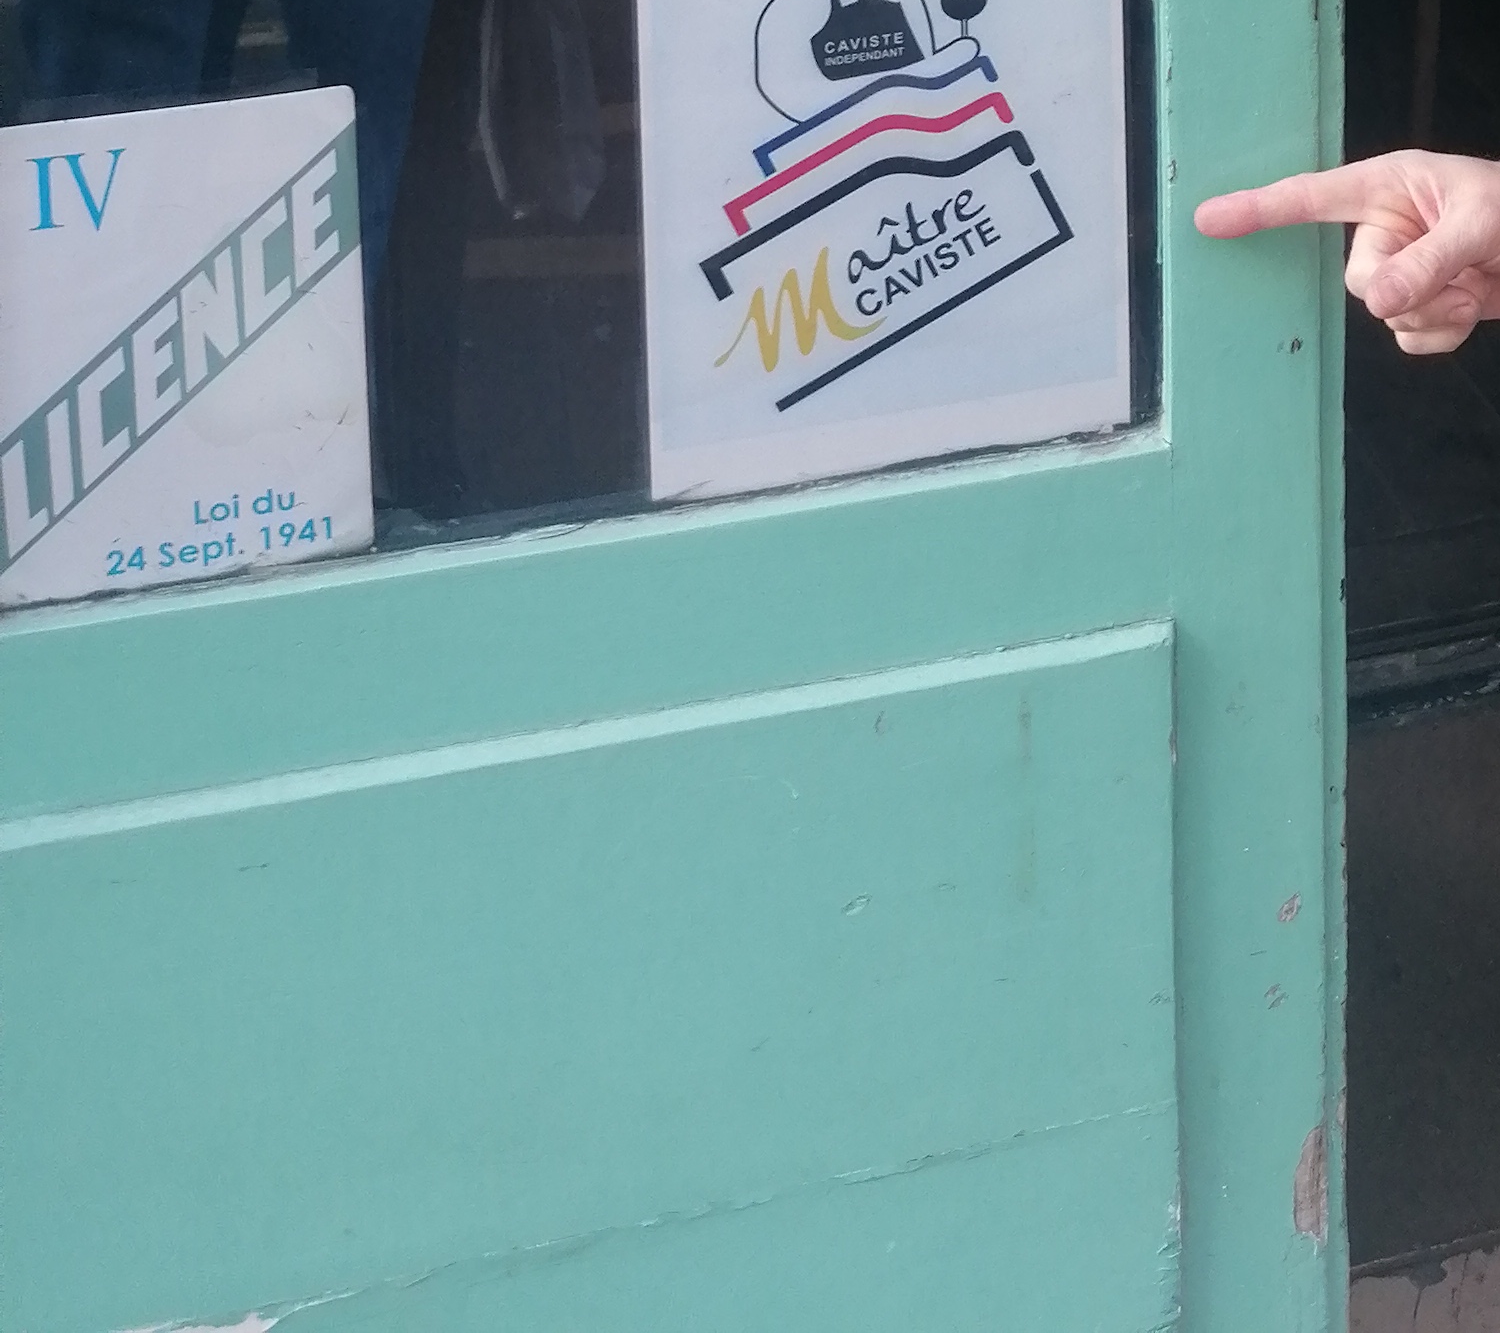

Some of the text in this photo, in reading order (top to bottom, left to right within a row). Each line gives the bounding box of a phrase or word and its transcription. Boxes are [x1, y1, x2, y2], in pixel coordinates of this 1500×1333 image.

[824, 31, 904, 54] CAVISTE
[824, 46, 906, 67] INDEPENDANT
[26, 148, 127, 232] IV
[854, 215, 1002, 317] CAVISTE
[1, 148, 342, 561] LICENCE
[193, 488, 296, 527] Loi du
[106, 516, 335, 577] 24 Sept. 1941
